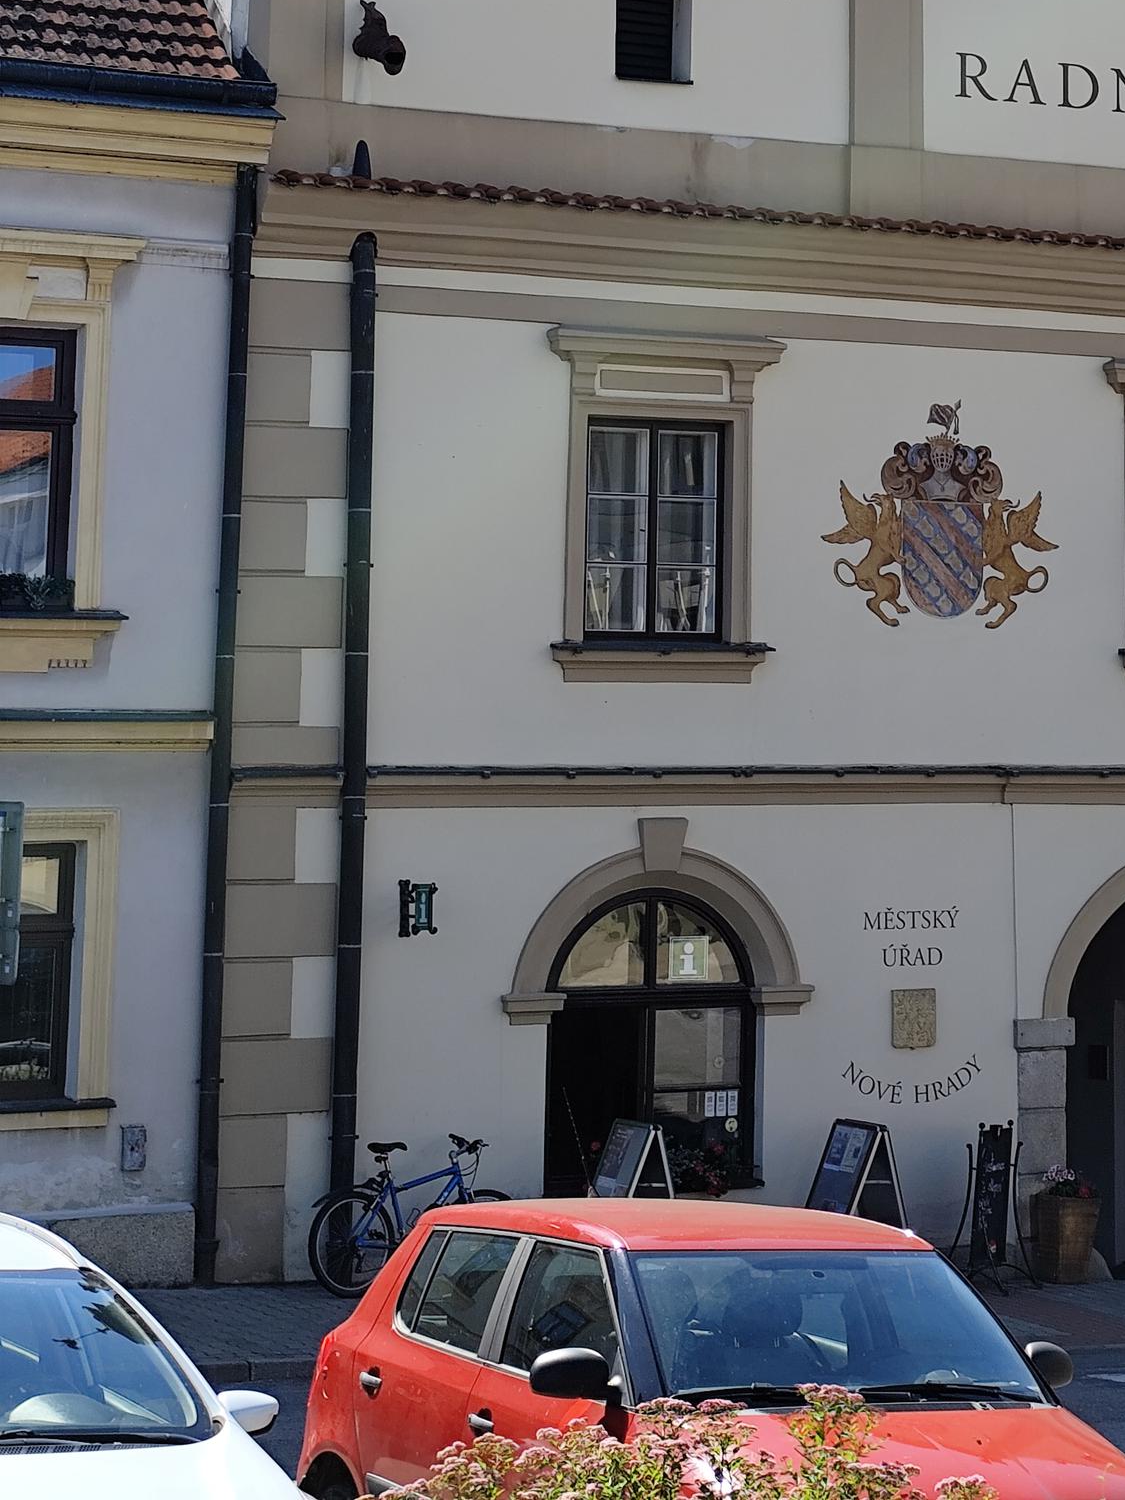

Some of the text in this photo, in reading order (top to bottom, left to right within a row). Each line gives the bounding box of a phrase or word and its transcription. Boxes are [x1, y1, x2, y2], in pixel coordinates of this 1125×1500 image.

[863, 906, 960, 931] MĚSTSKÝ
[882, 943, 943, 968] ÚŘAD
[842, 1054, 983, 1104] NOVÉ HRADY
